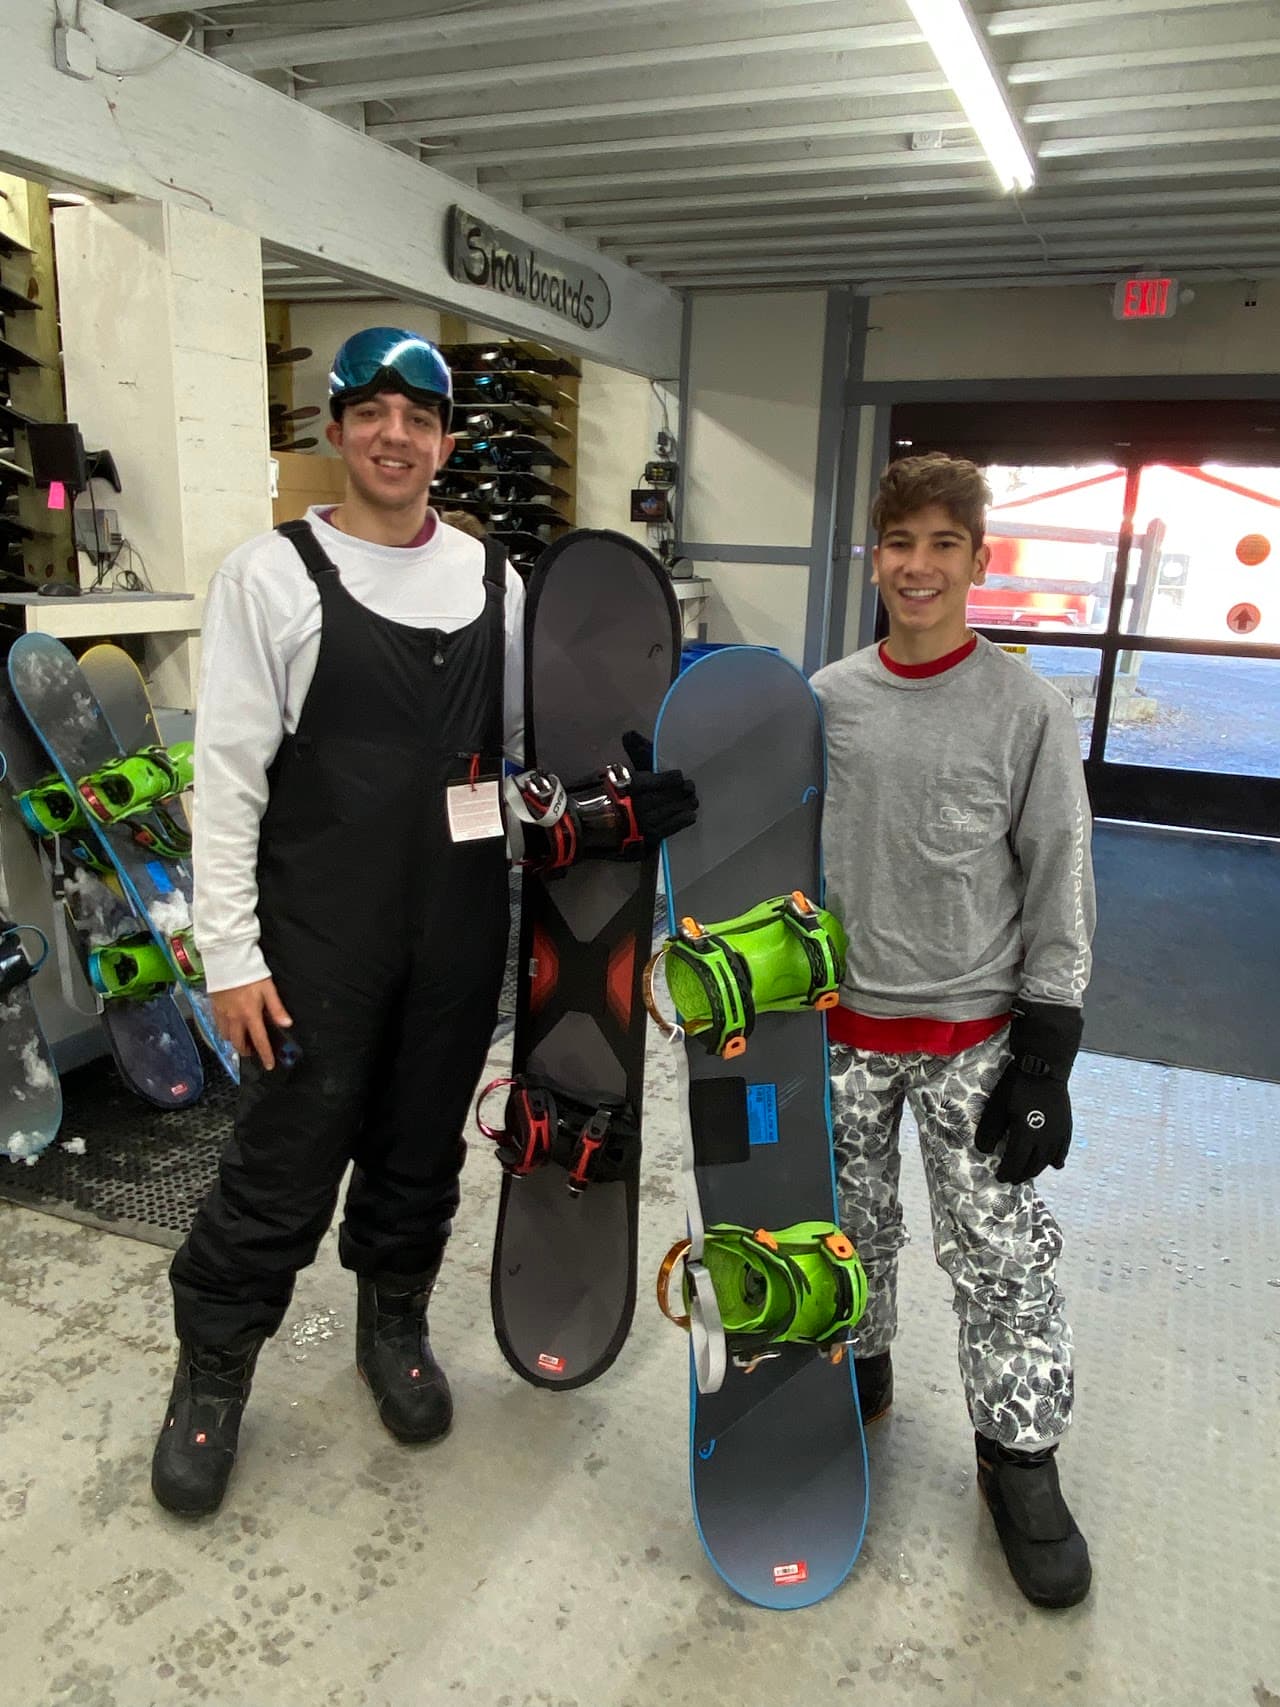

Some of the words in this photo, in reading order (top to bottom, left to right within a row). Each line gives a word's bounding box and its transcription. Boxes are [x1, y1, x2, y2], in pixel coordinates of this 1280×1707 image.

[463, 228, 594, 328] Snowboards
[1123, 278, 1172, 318] EXIT
[1070, 796, 1084, 931] vineyard
[1071, 933, 1087, 993] vine
